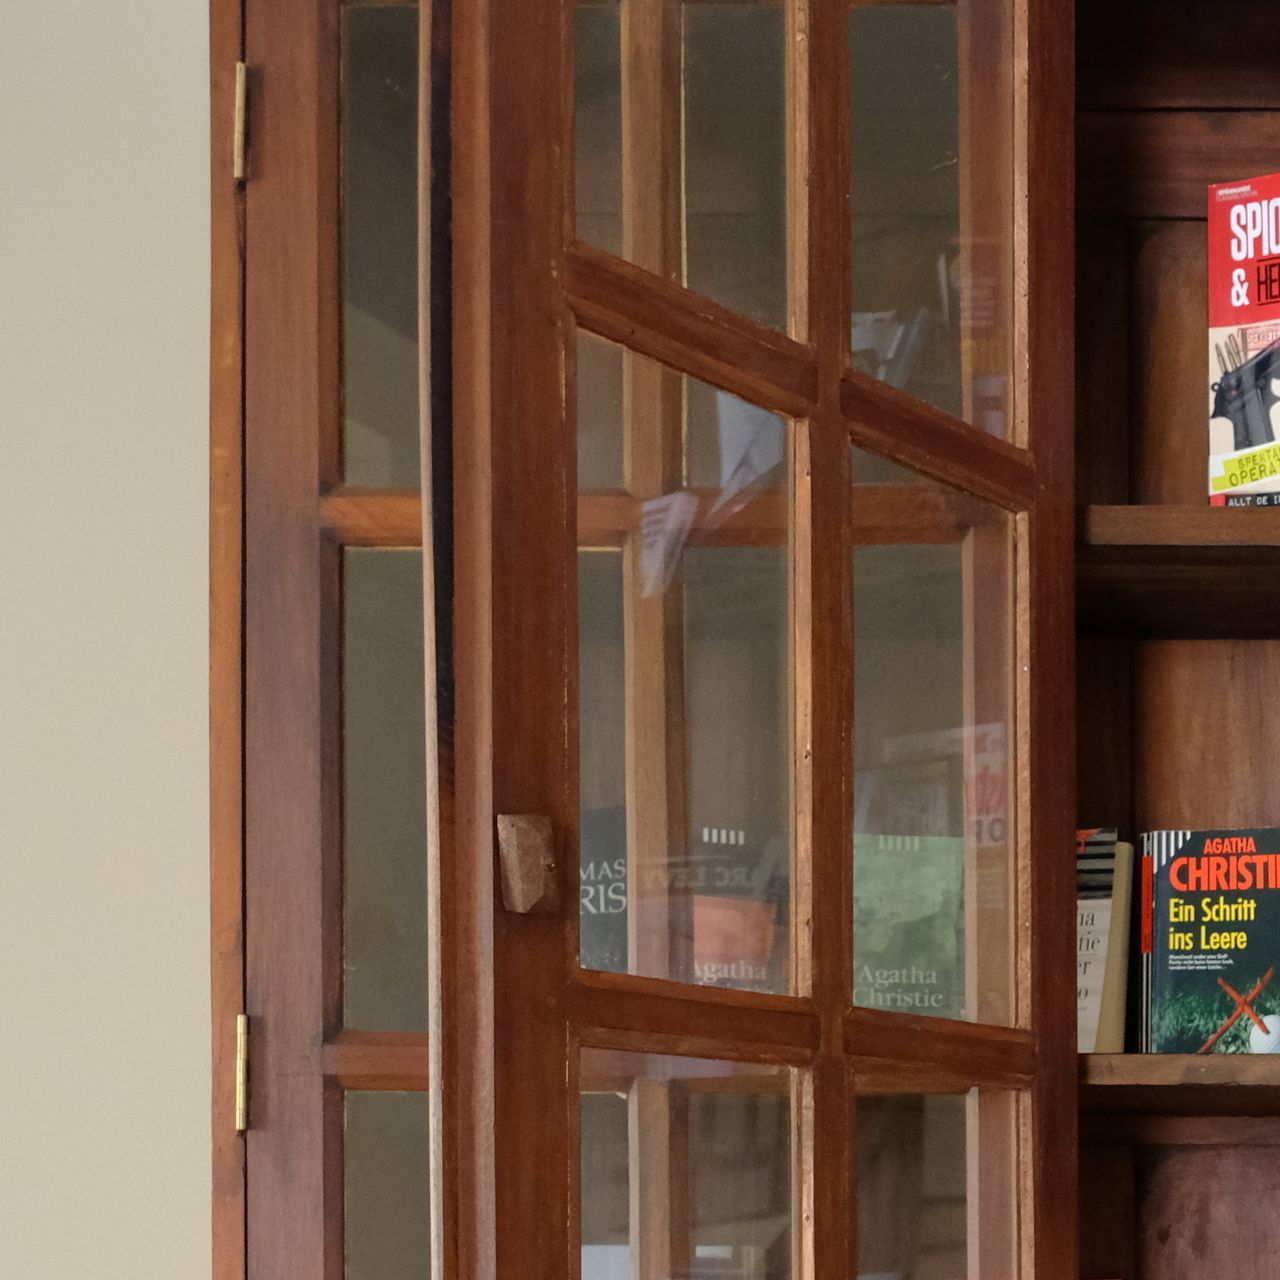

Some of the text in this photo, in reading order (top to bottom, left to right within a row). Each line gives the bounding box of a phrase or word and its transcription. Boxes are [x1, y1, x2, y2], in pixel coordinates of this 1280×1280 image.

[1230, 267, 1250, 308] &
[1203, 836, 1257, 854] AGATHA
[1168, 896, 1257, 923] Ein Schritt
[1168, 925, 1248, 951] ins Leere
[858, 964, 938, 988] Agatha
